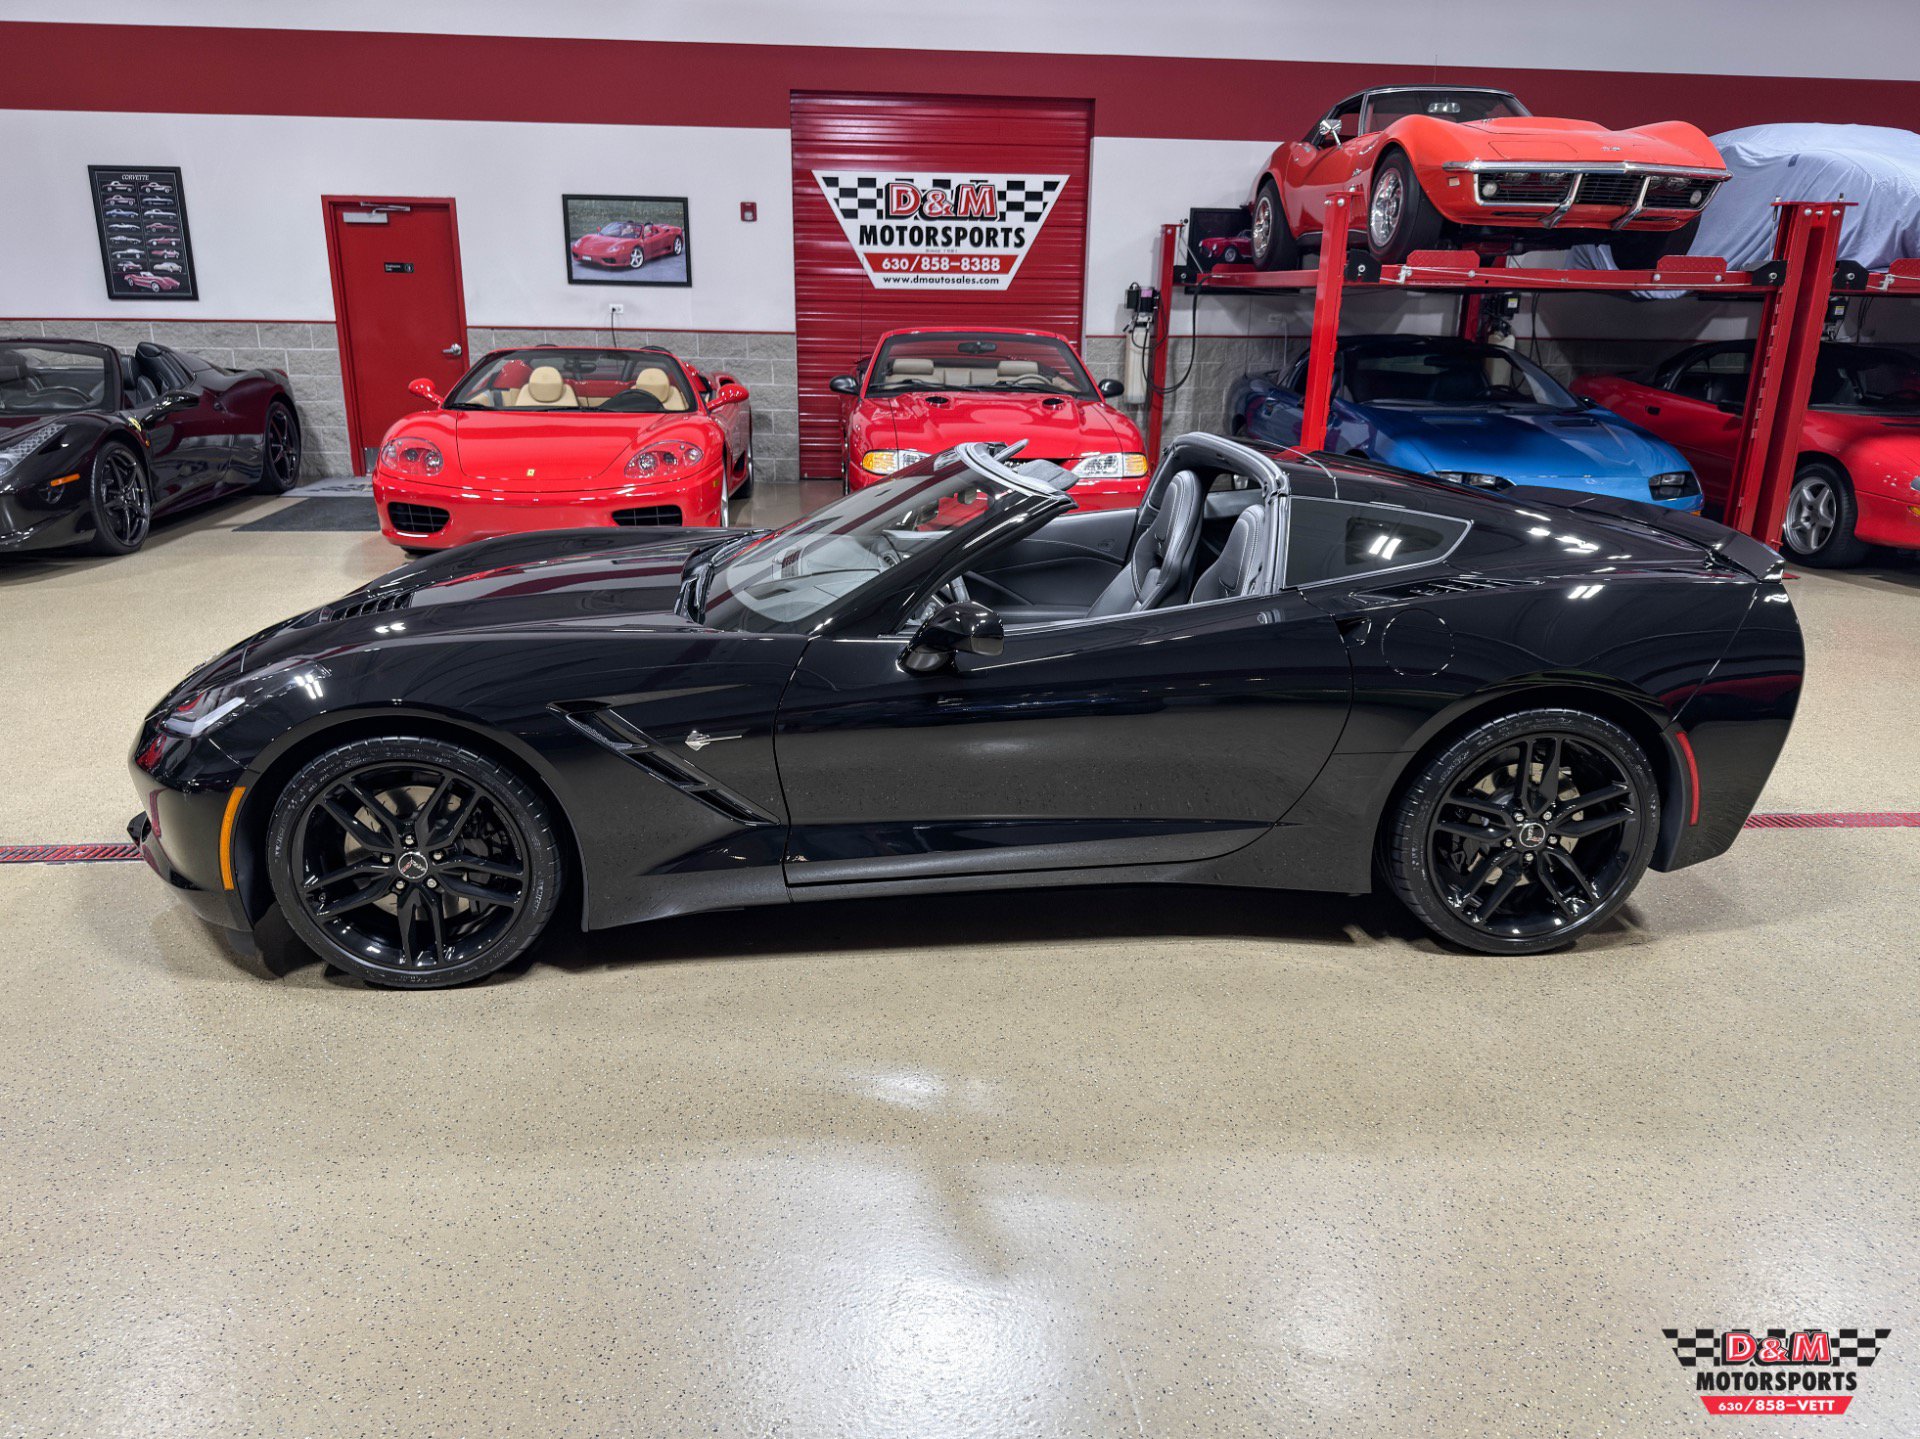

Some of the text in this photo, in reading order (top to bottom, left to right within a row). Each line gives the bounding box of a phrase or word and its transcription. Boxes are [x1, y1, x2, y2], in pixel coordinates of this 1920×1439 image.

[885, 182, 999, 220] D&M
[859, 225, 1025, 248] MOTORSPORTS
[882, 255, 1000, 272] 630/858-8388
[883, 275, 999, 285] www.dmautosales.com
